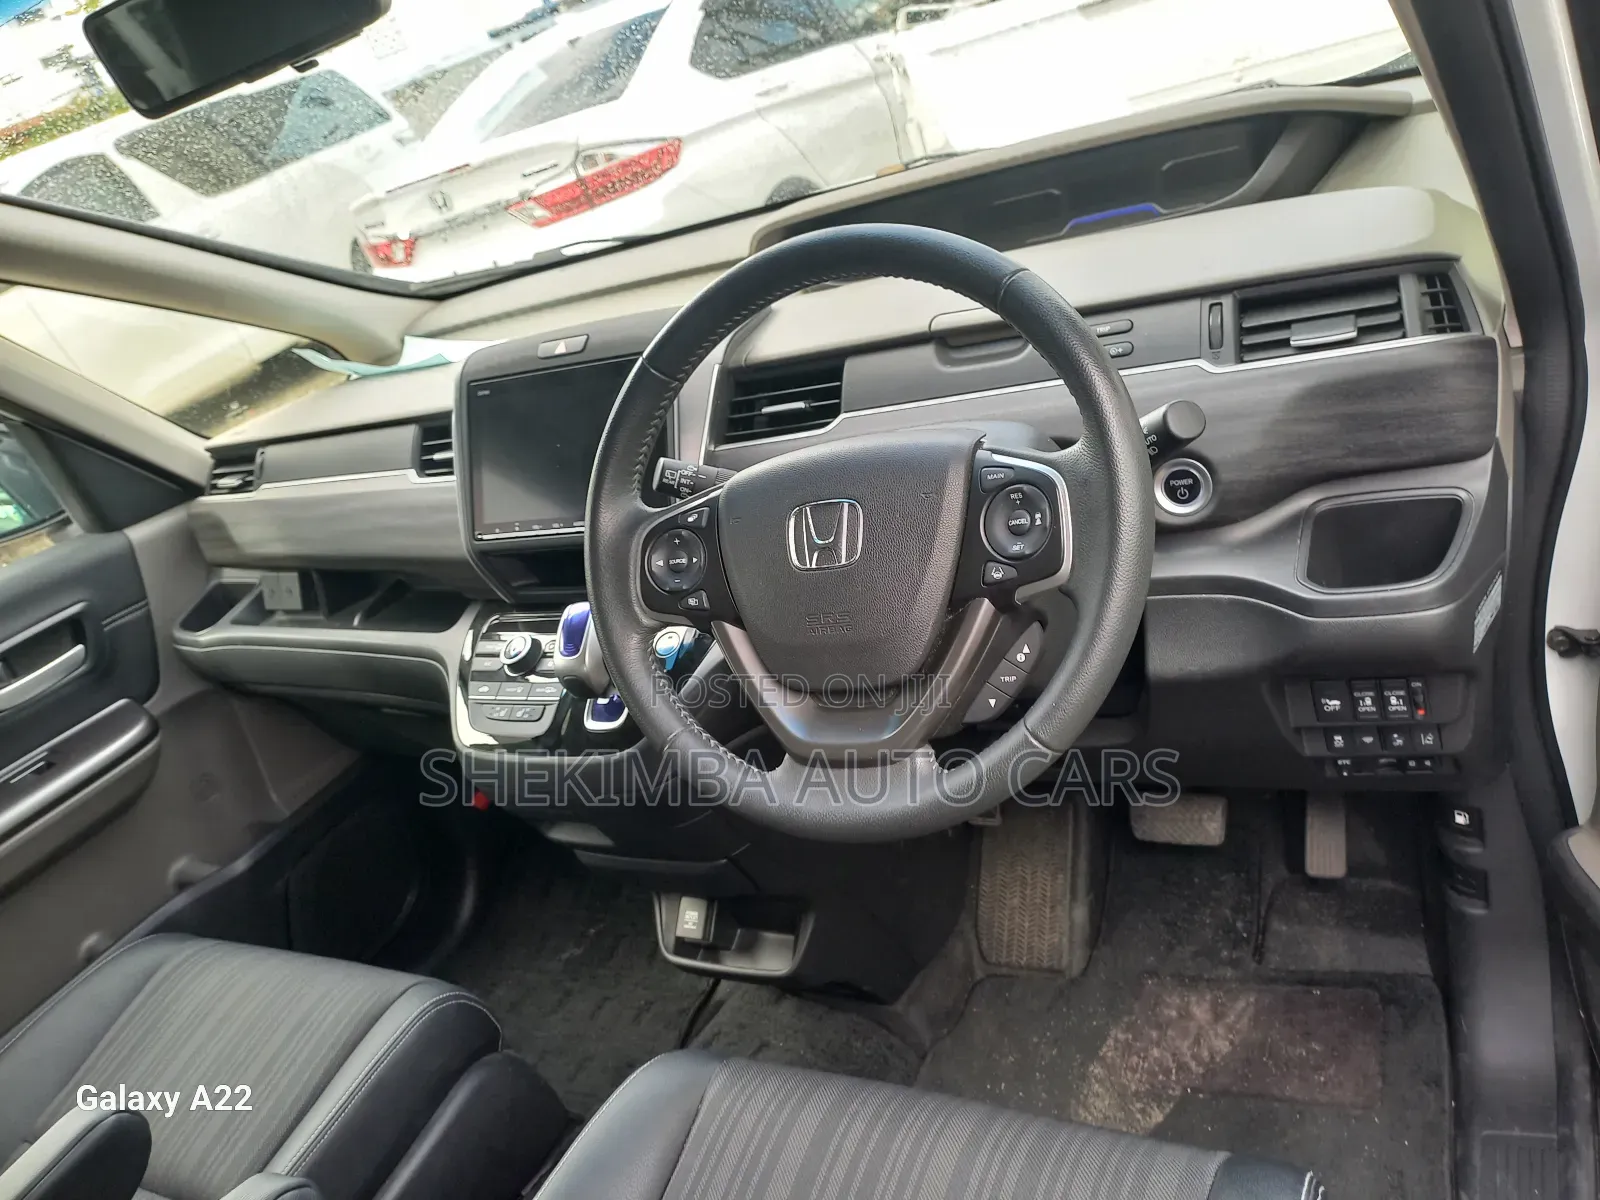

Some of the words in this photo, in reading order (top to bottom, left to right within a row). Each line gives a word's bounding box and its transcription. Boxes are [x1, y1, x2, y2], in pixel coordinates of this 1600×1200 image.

[1169, 478, 1193, 486] POWER
[1010, 492, 1023, 500] RES
[1008, 518, 1028, 526] CANCEL
[668, 557, 686, 565] SOURCE
[805, 612, 850, 625] SRS
[809, 626, 851, 636] AIRBAG
[1000, 675, 1017, 683] TRIP
